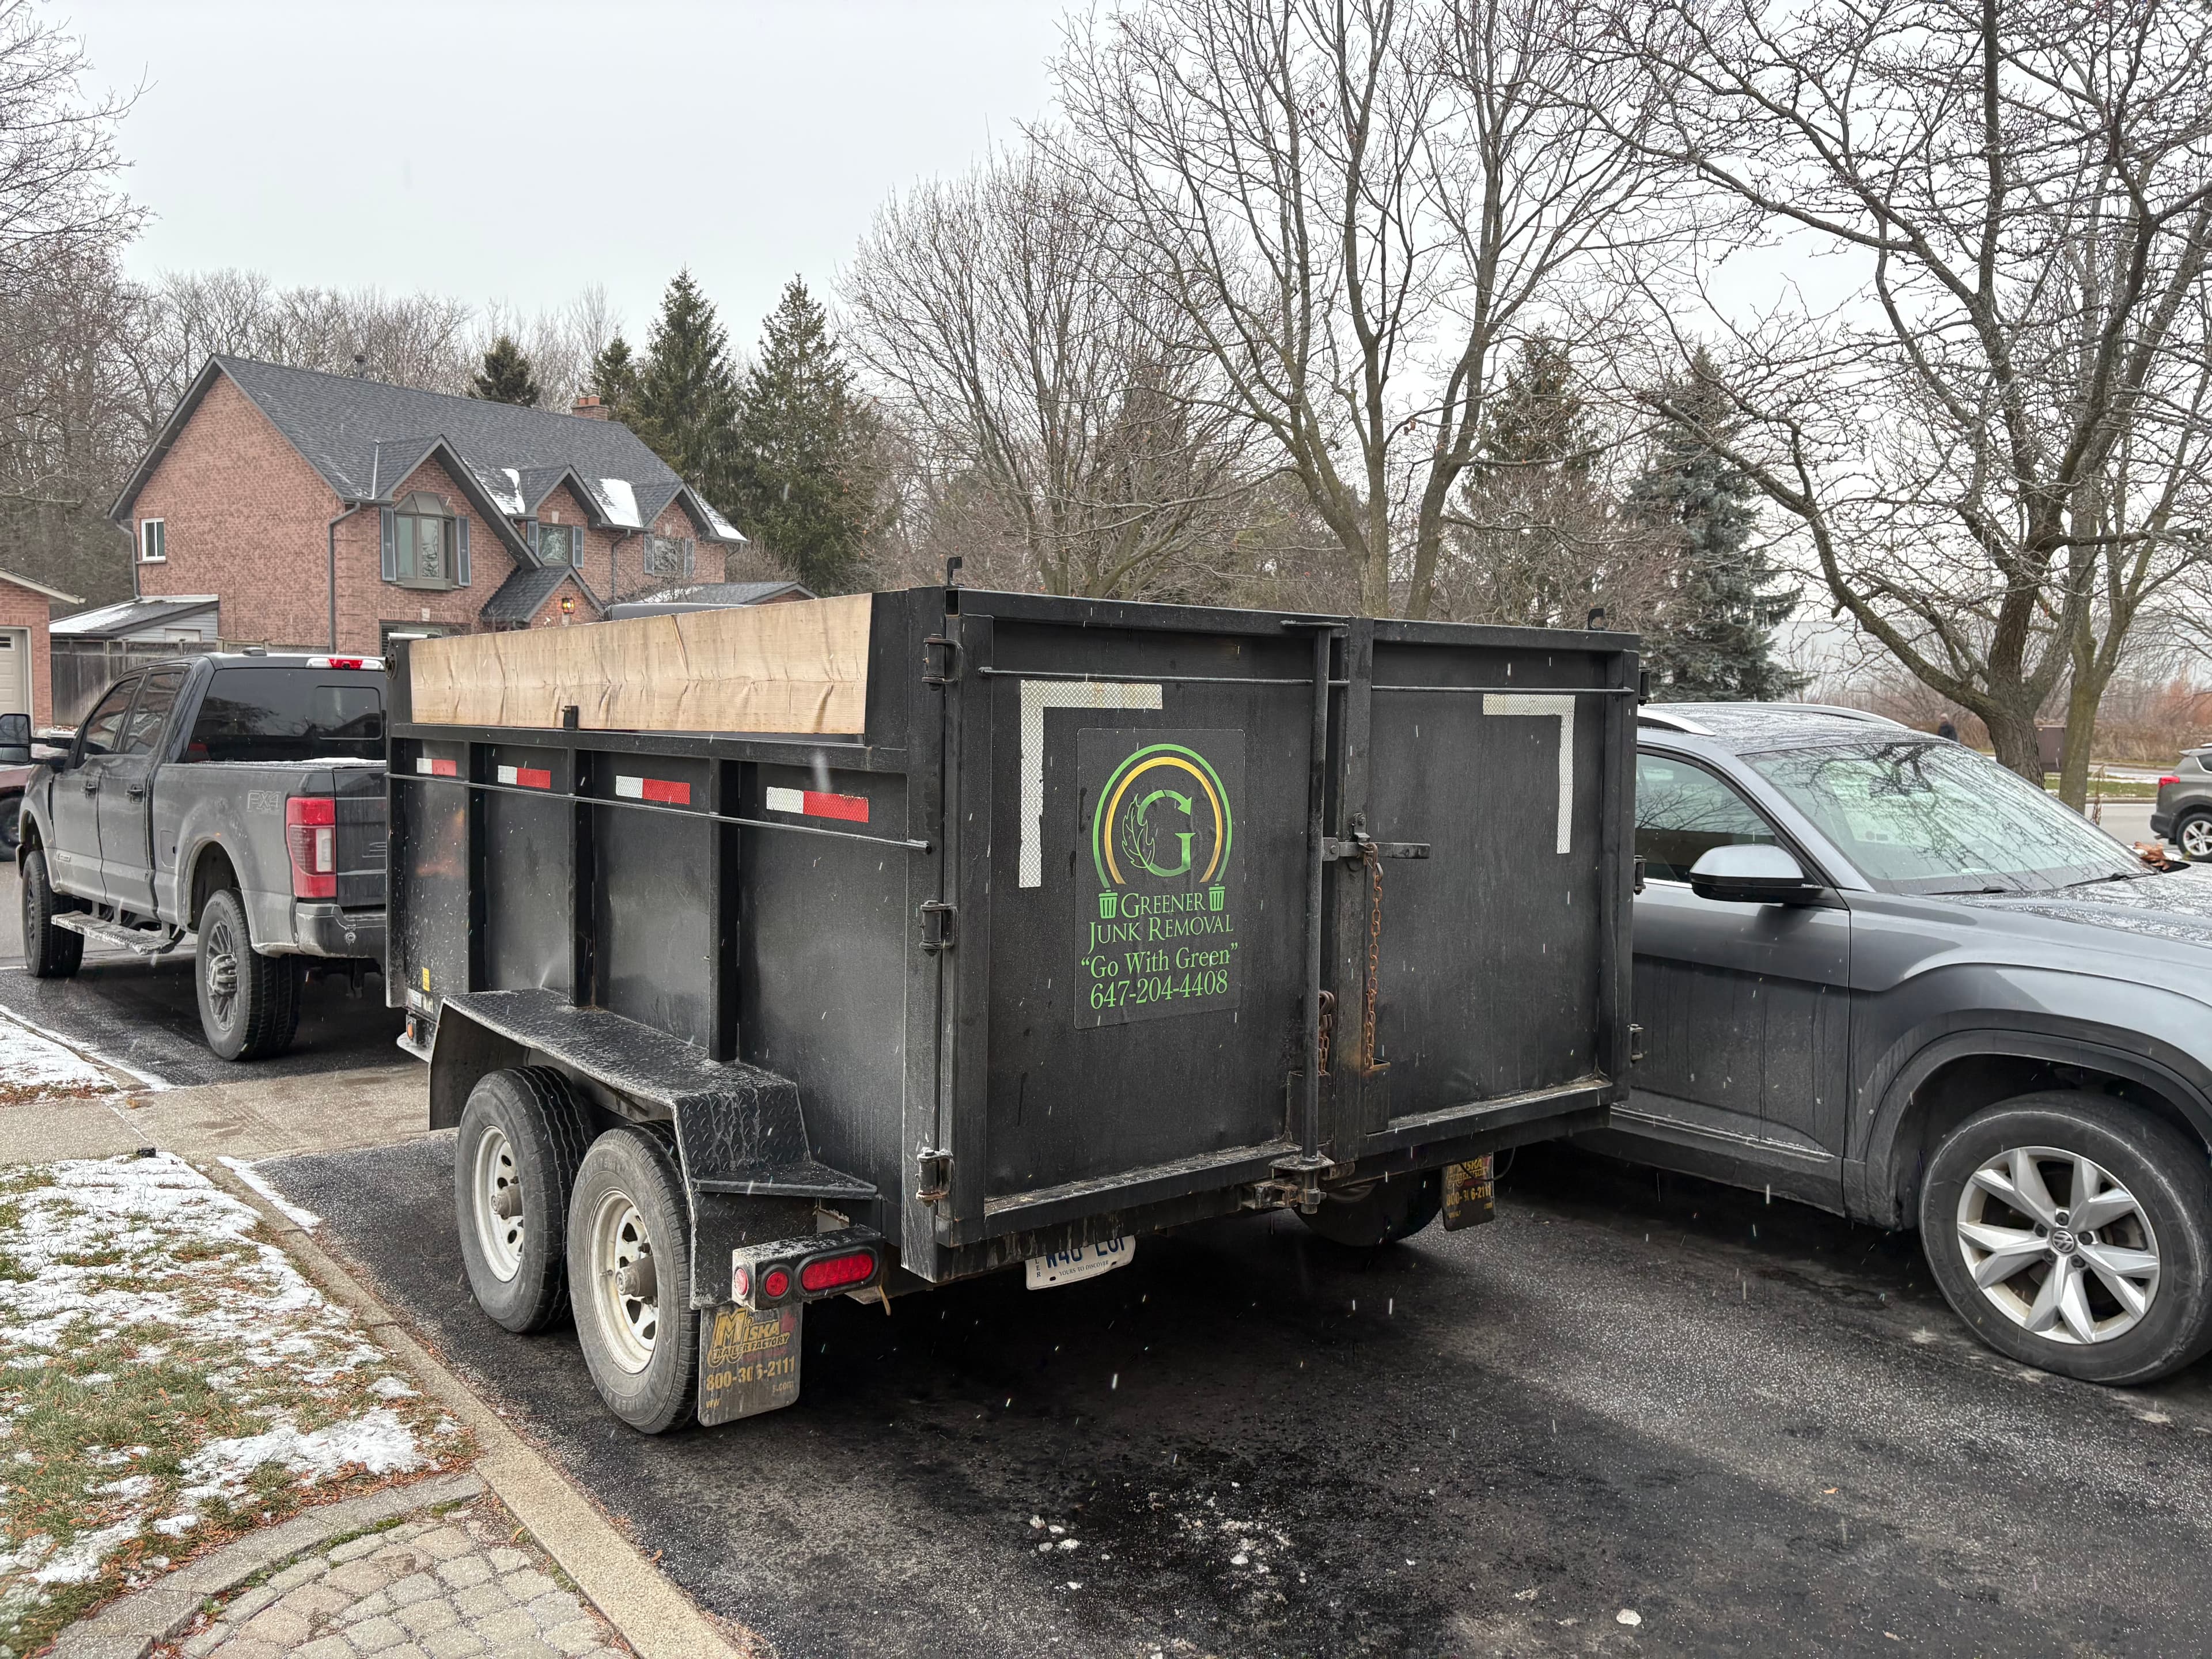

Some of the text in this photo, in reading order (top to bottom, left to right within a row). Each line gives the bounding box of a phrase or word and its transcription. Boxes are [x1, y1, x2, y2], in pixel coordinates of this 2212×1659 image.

[248, 789, 281, 812] FX4
[1121, 893, 1206, 918] GREENER
[1088, 914, 1234, 955] JUNK REMOVAL
[1124, 949, 1170, 974] With
[1090, 969, 1228, 1009] 647-204-4408
[1059, 1268, 1076, 1277] YOURS
[1085, 1260, 1109, 1271] DISCOVER
[751, 1334, 789, 1352] FACTORY
